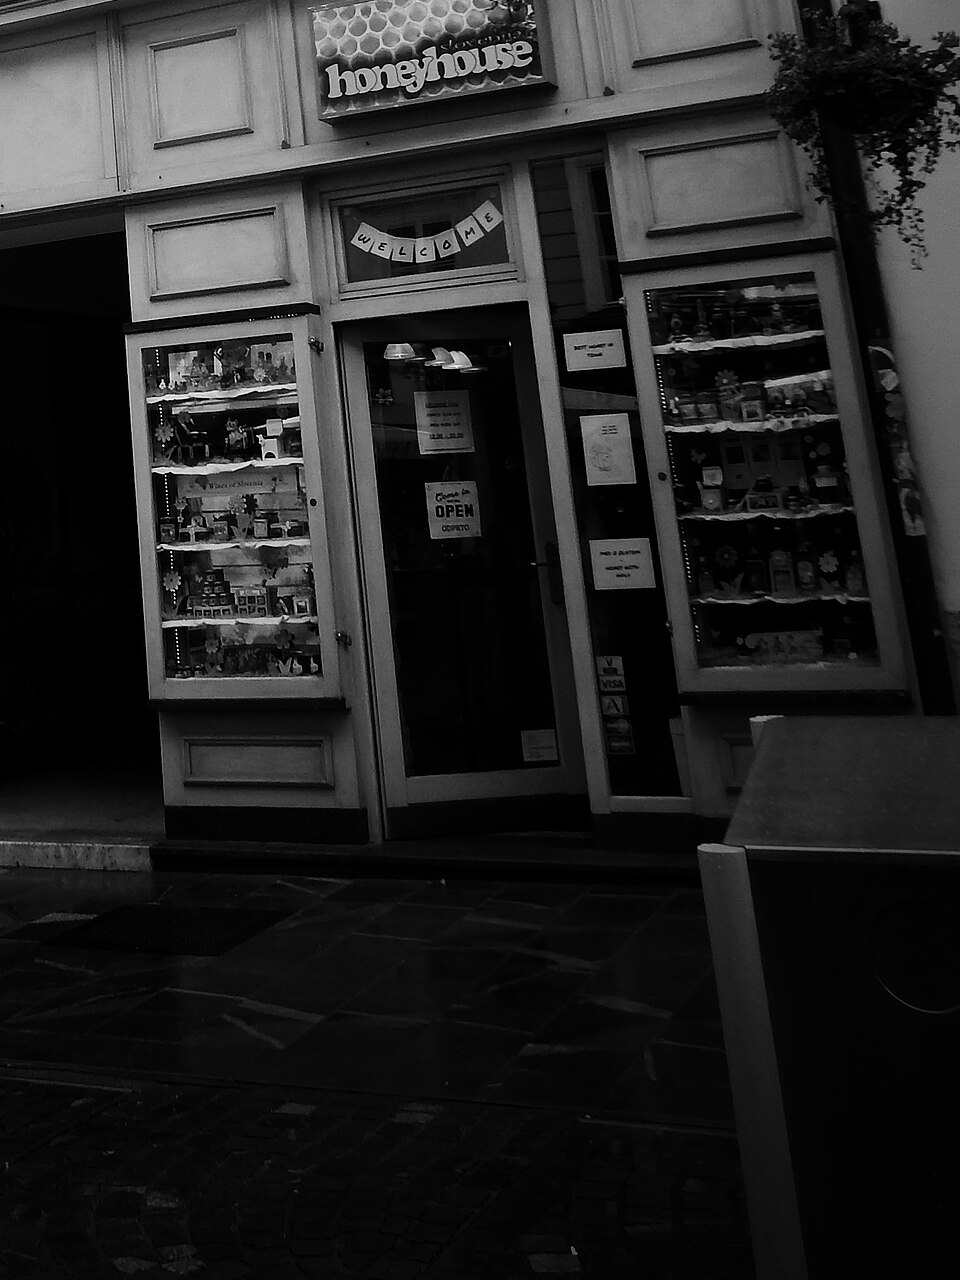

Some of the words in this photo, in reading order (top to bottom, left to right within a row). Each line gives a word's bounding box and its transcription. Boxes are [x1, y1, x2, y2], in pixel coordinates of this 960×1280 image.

[325, 40, 534, 99] honeyhouse
[357, 212, 494, 256] WELCOME
[435, 504, 474, 518] OPEN
[601, 679, 625, 689] VISA
